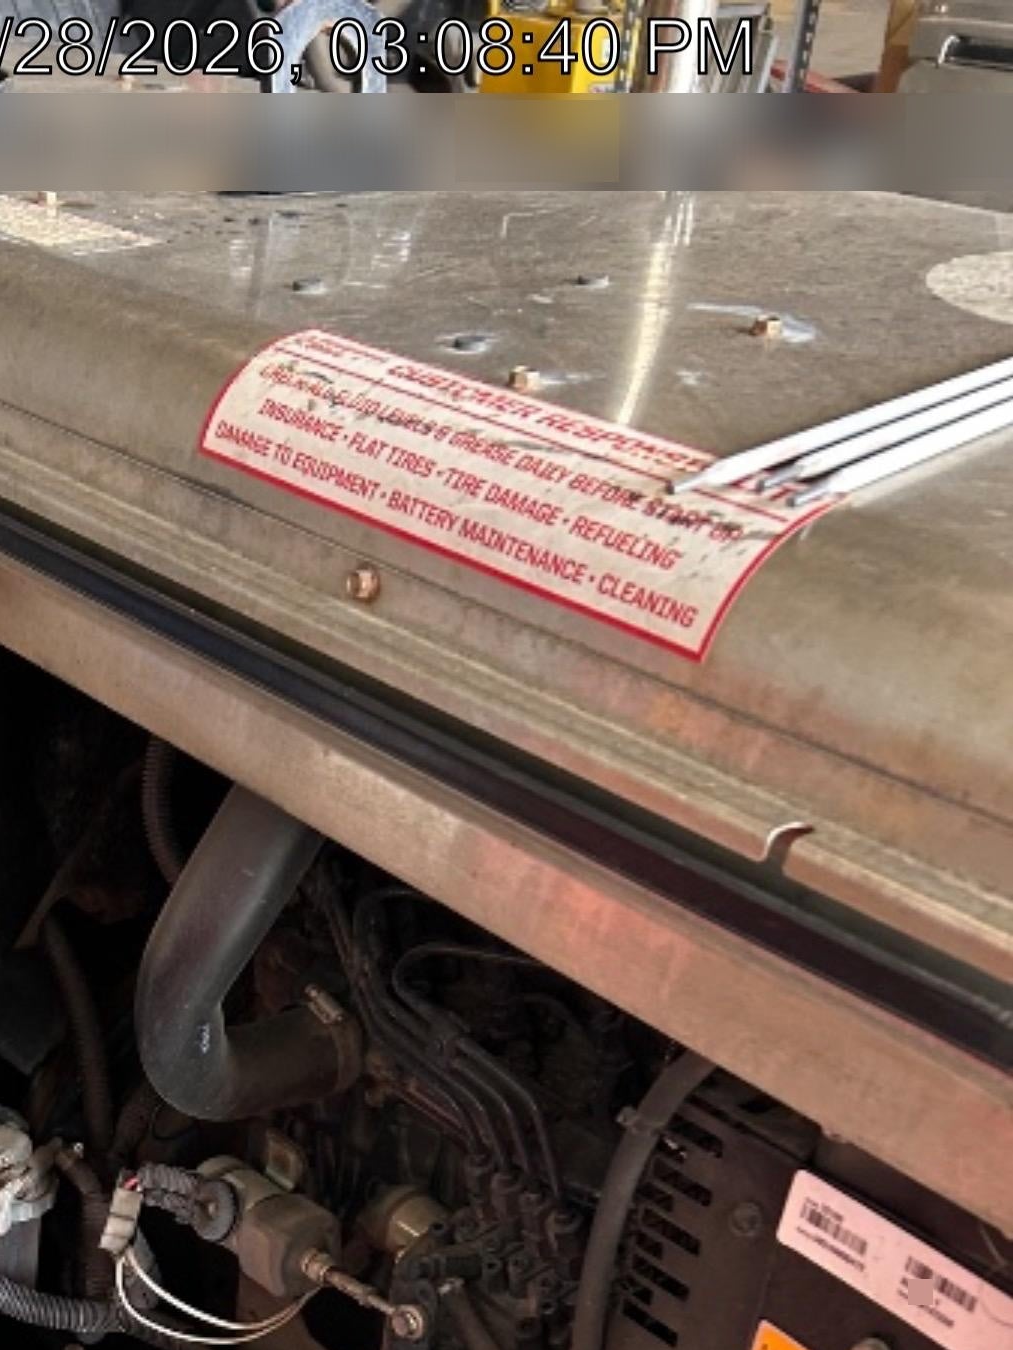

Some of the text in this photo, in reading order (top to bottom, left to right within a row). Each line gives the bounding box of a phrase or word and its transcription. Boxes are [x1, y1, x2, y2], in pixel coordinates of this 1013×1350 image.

[214, 419, 699, 628] DAMAGE TO EQUIPMENT BATTERY MAINTENANCE CLEANING
[257, 398, 682, 572] INSURANCE FLAT TIRES TIRE DAMAGE REFUELING
[449, 430, 517, 465] GREASE
[515, 454, 573, 483] DAILY
[568, 474, 642, 511] BEFORE
